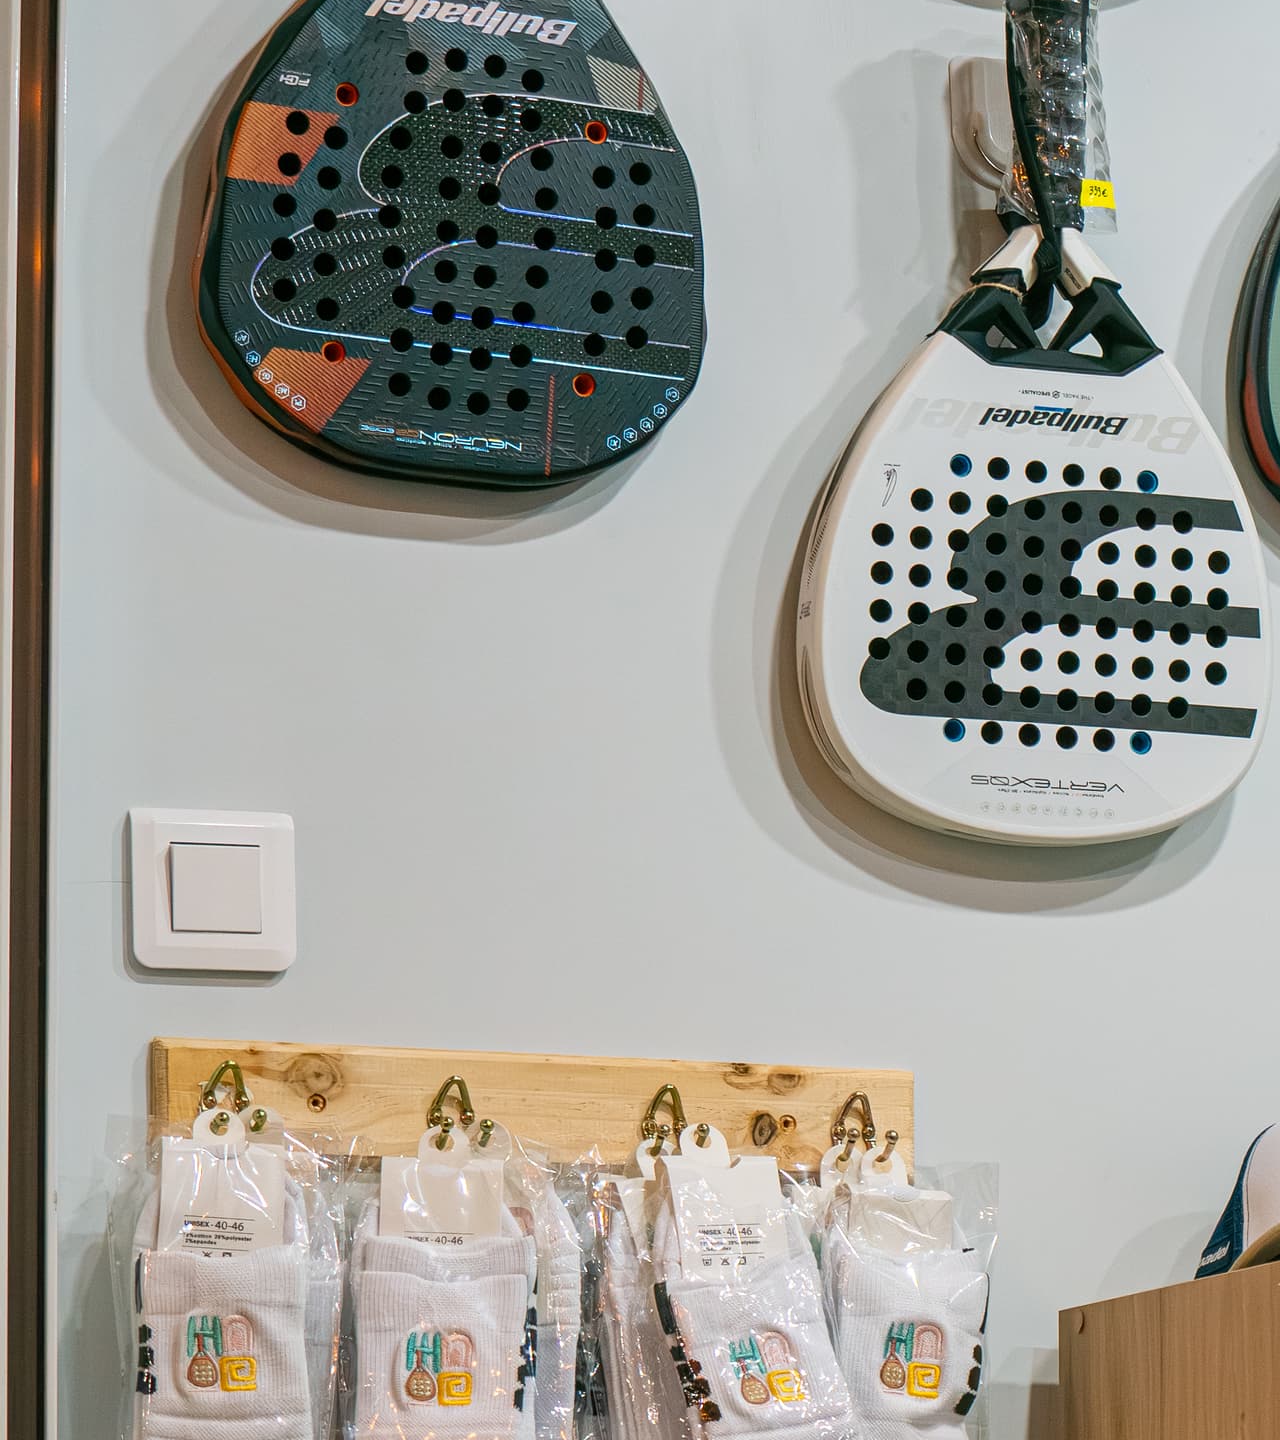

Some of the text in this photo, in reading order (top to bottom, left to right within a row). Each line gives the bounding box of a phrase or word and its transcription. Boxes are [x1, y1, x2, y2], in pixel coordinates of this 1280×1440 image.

[980, 406, 1128, 437] Bullpadel
[214, 1220, 245, 1232] 40-46
[435, 1236, 464, 1246] 40-46
